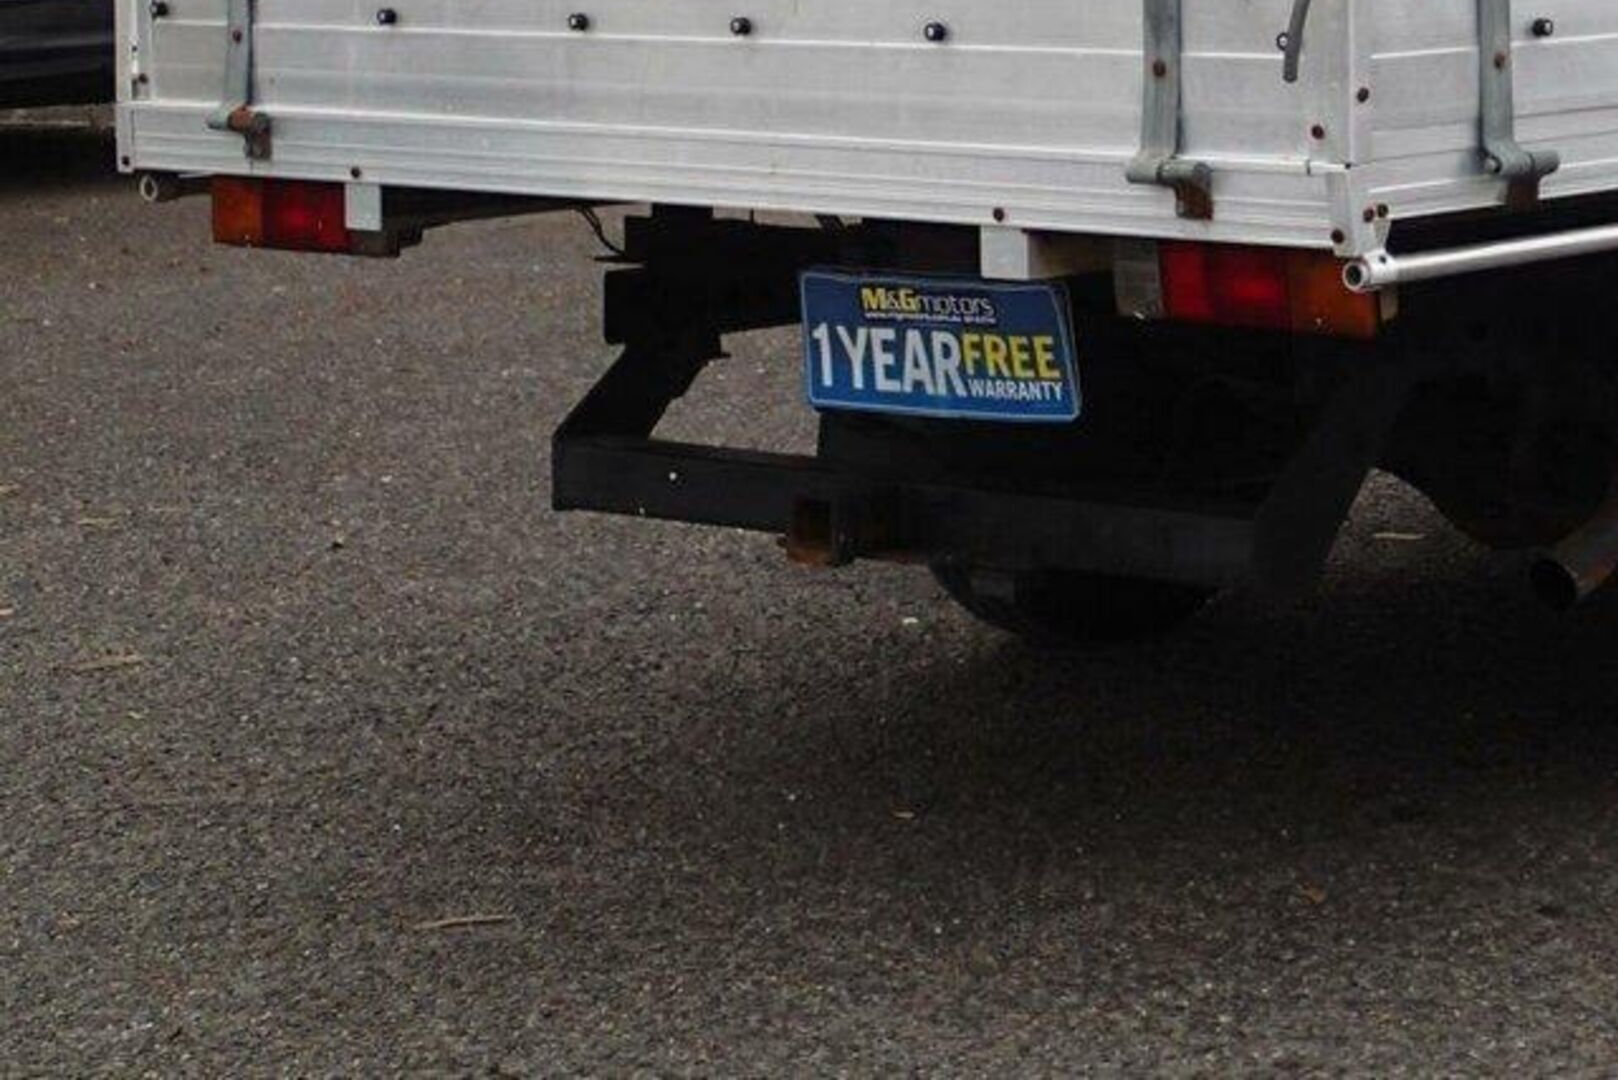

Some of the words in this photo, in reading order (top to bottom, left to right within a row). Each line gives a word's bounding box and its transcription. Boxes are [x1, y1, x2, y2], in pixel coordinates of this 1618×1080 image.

[812, 322, 833, 388] 1
[837, 325, 968, 397] YEAR
[961, 333, 1061, 379] FREE
[967, 378, 1064, 402] WARRANTY
